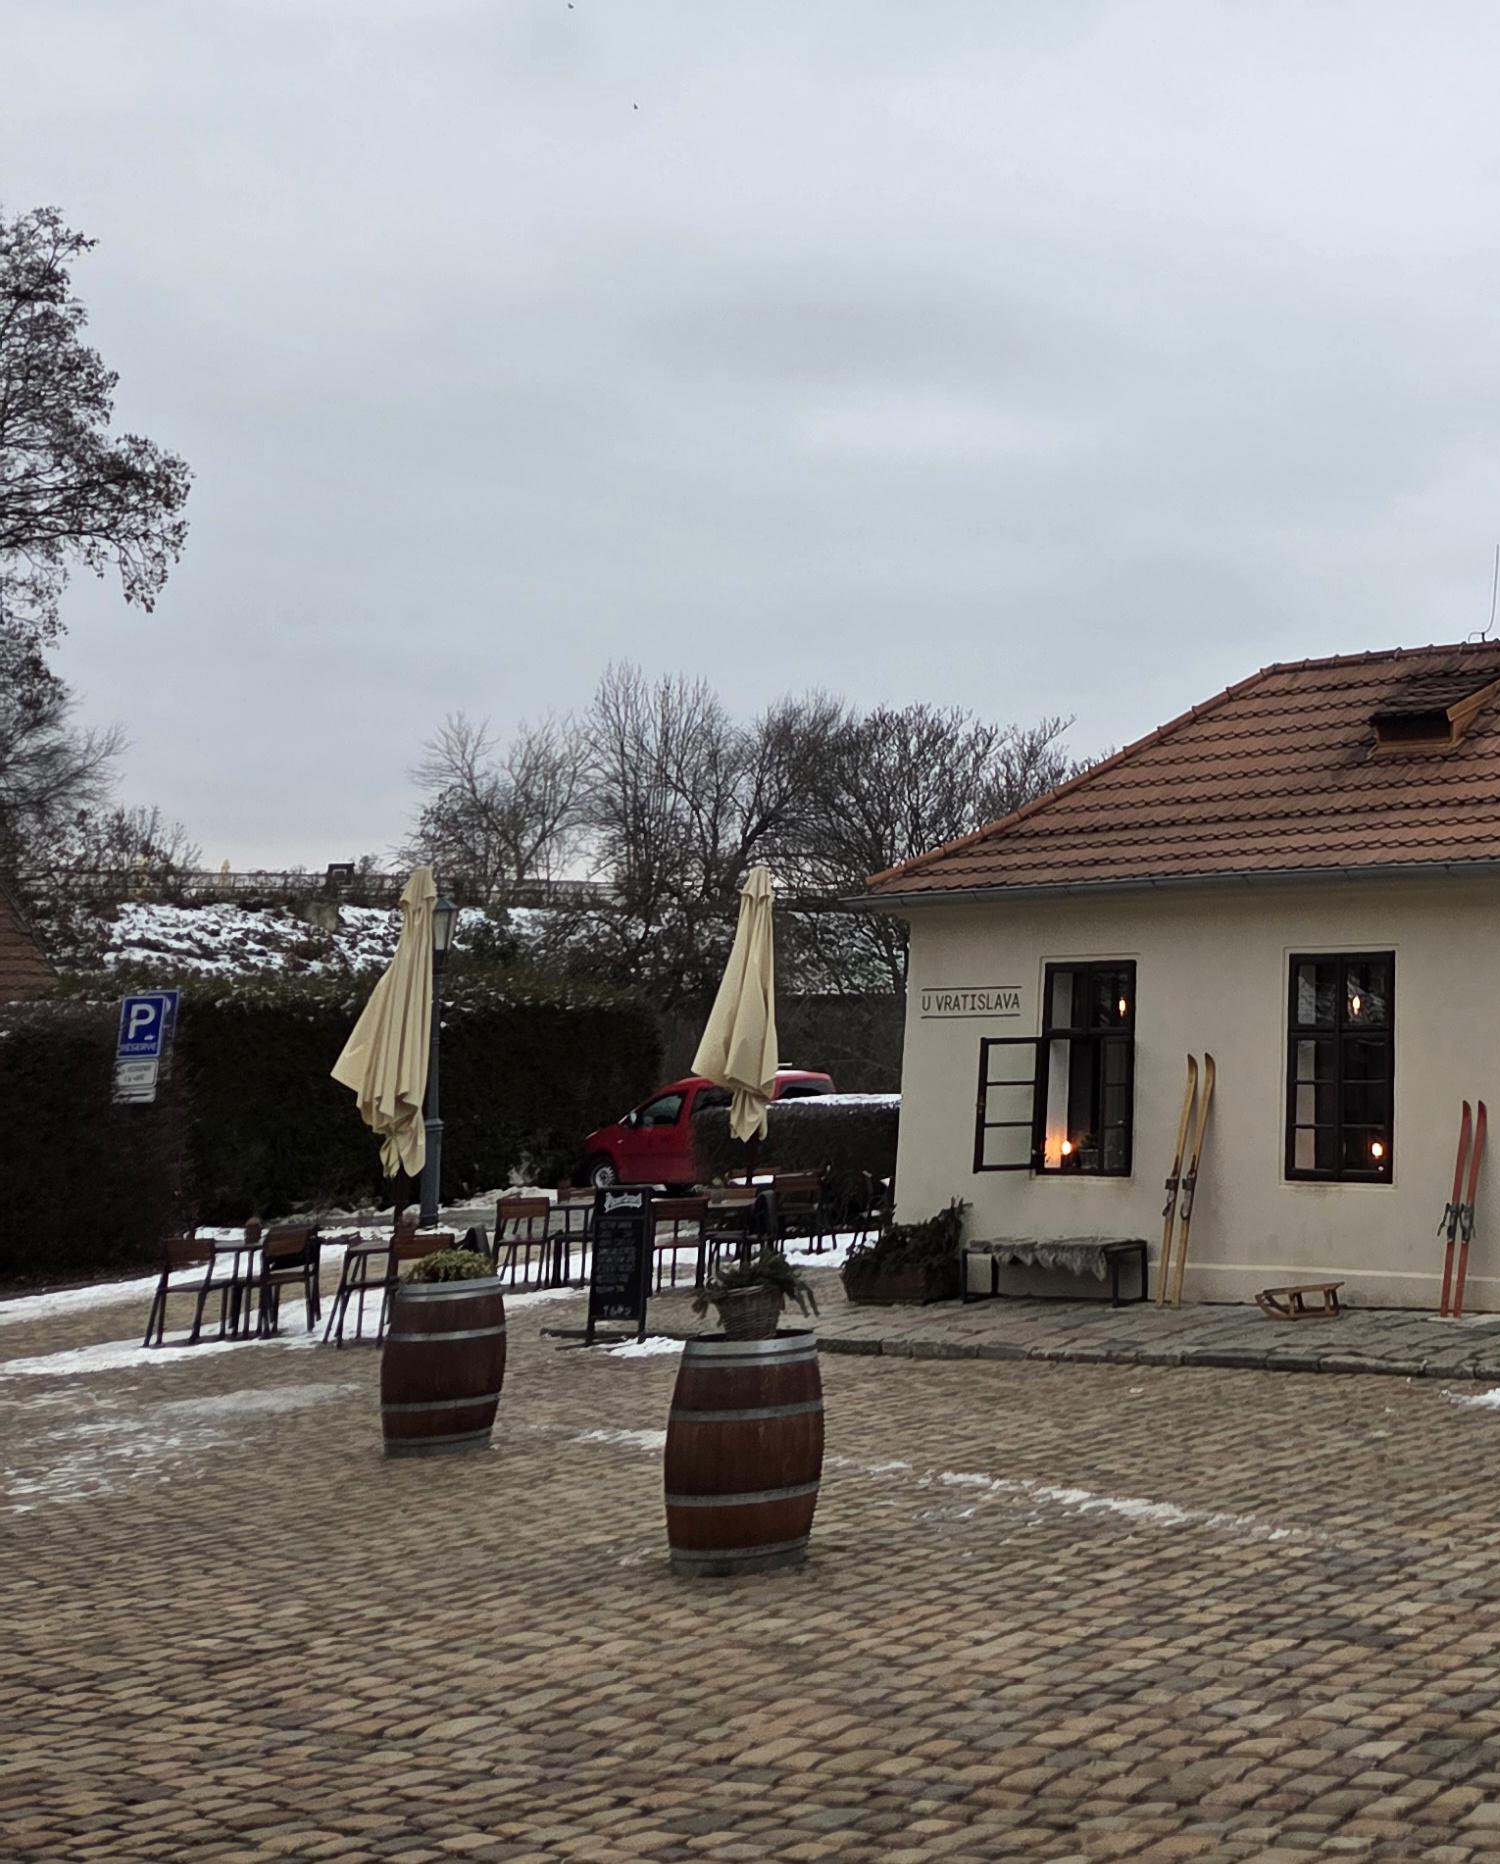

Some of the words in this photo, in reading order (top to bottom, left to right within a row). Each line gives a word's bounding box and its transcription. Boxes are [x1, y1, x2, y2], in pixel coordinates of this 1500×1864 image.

[922, 995, 931, 1011] U
[936, 993, 1020, 1011] VRATISLAVA
[128, 1003, 156, 1040] P
